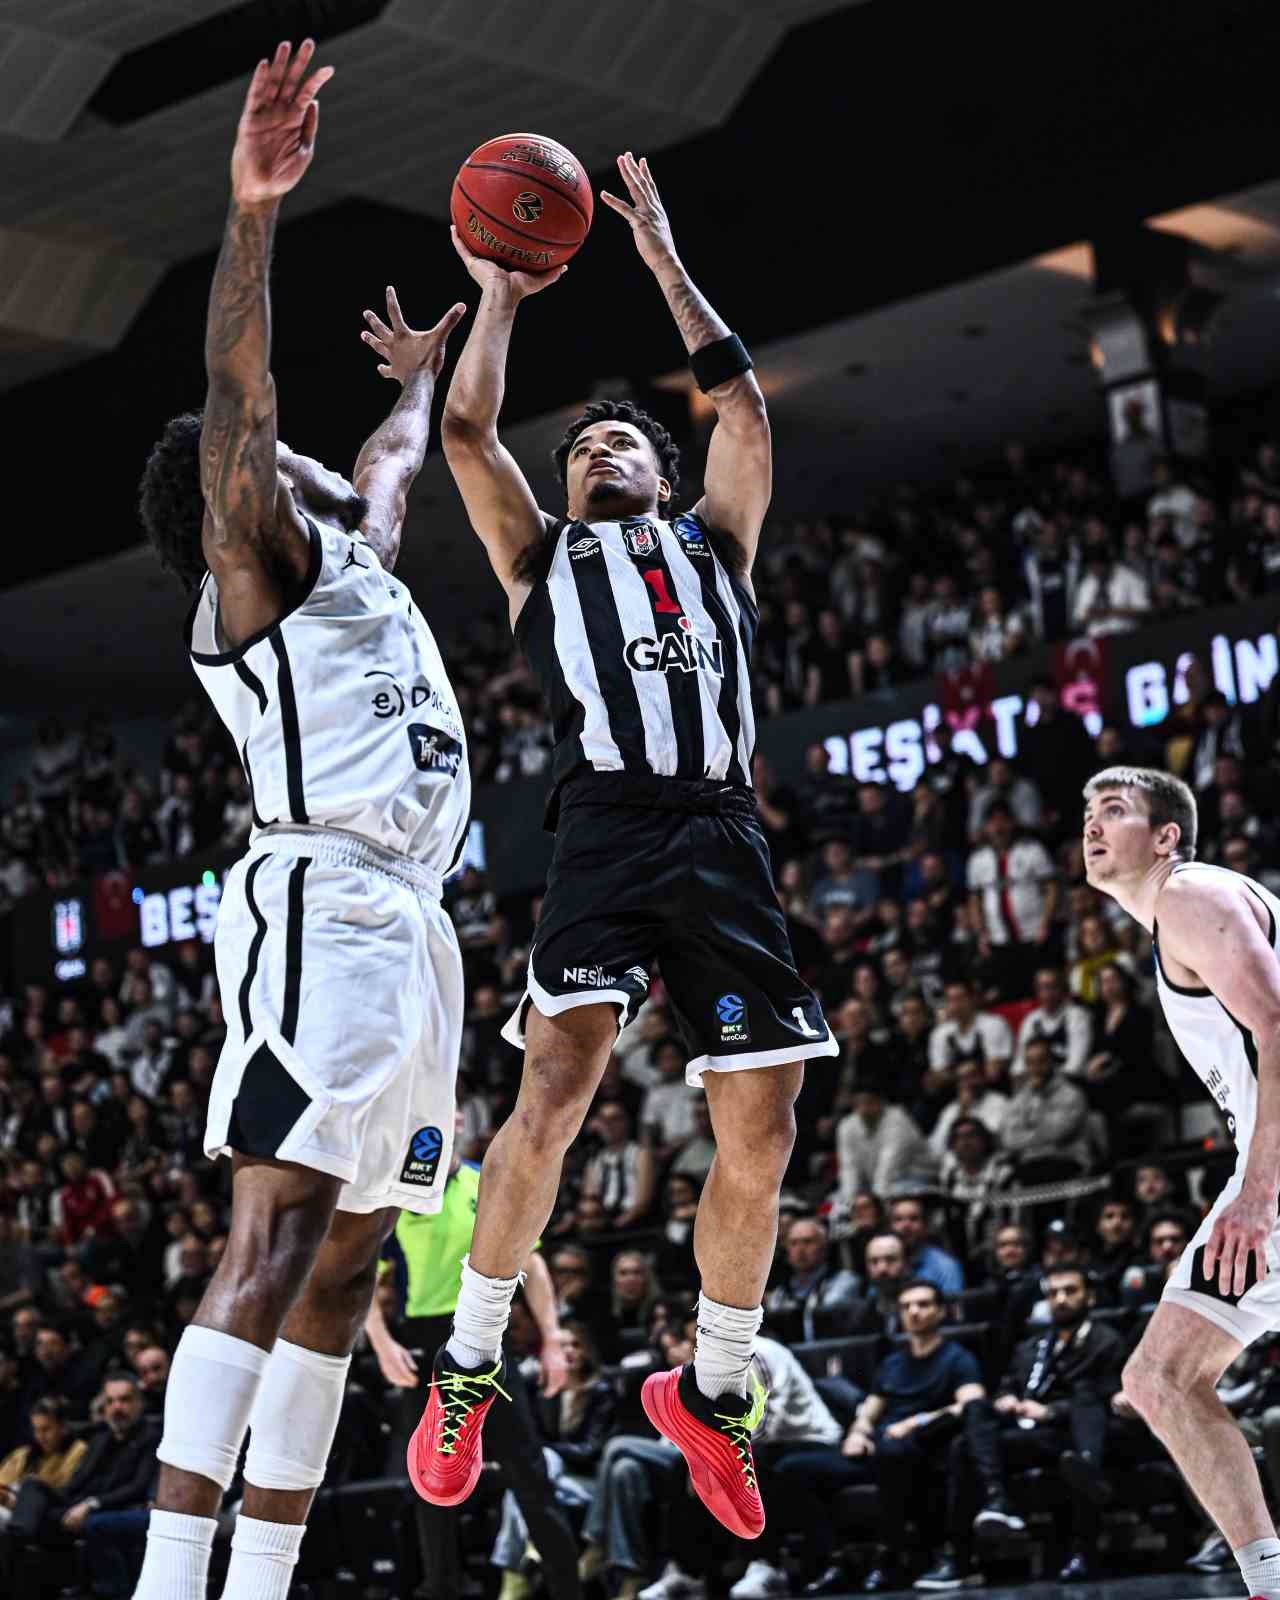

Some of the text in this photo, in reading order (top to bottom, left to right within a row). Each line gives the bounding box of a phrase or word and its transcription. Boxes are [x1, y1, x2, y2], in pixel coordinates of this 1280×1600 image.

[572, 547, 600, 560] umbro
[642, 568, 681, 615] 1
[791, 1006, 820, 1037] 1
[721, 1024, 743, 1033] BKT
[720, 1033, 748, 1042] EuroCup
[409, 1161, 433, 1172] BKT
[403, 1171, 433, 1183] EuroCup
